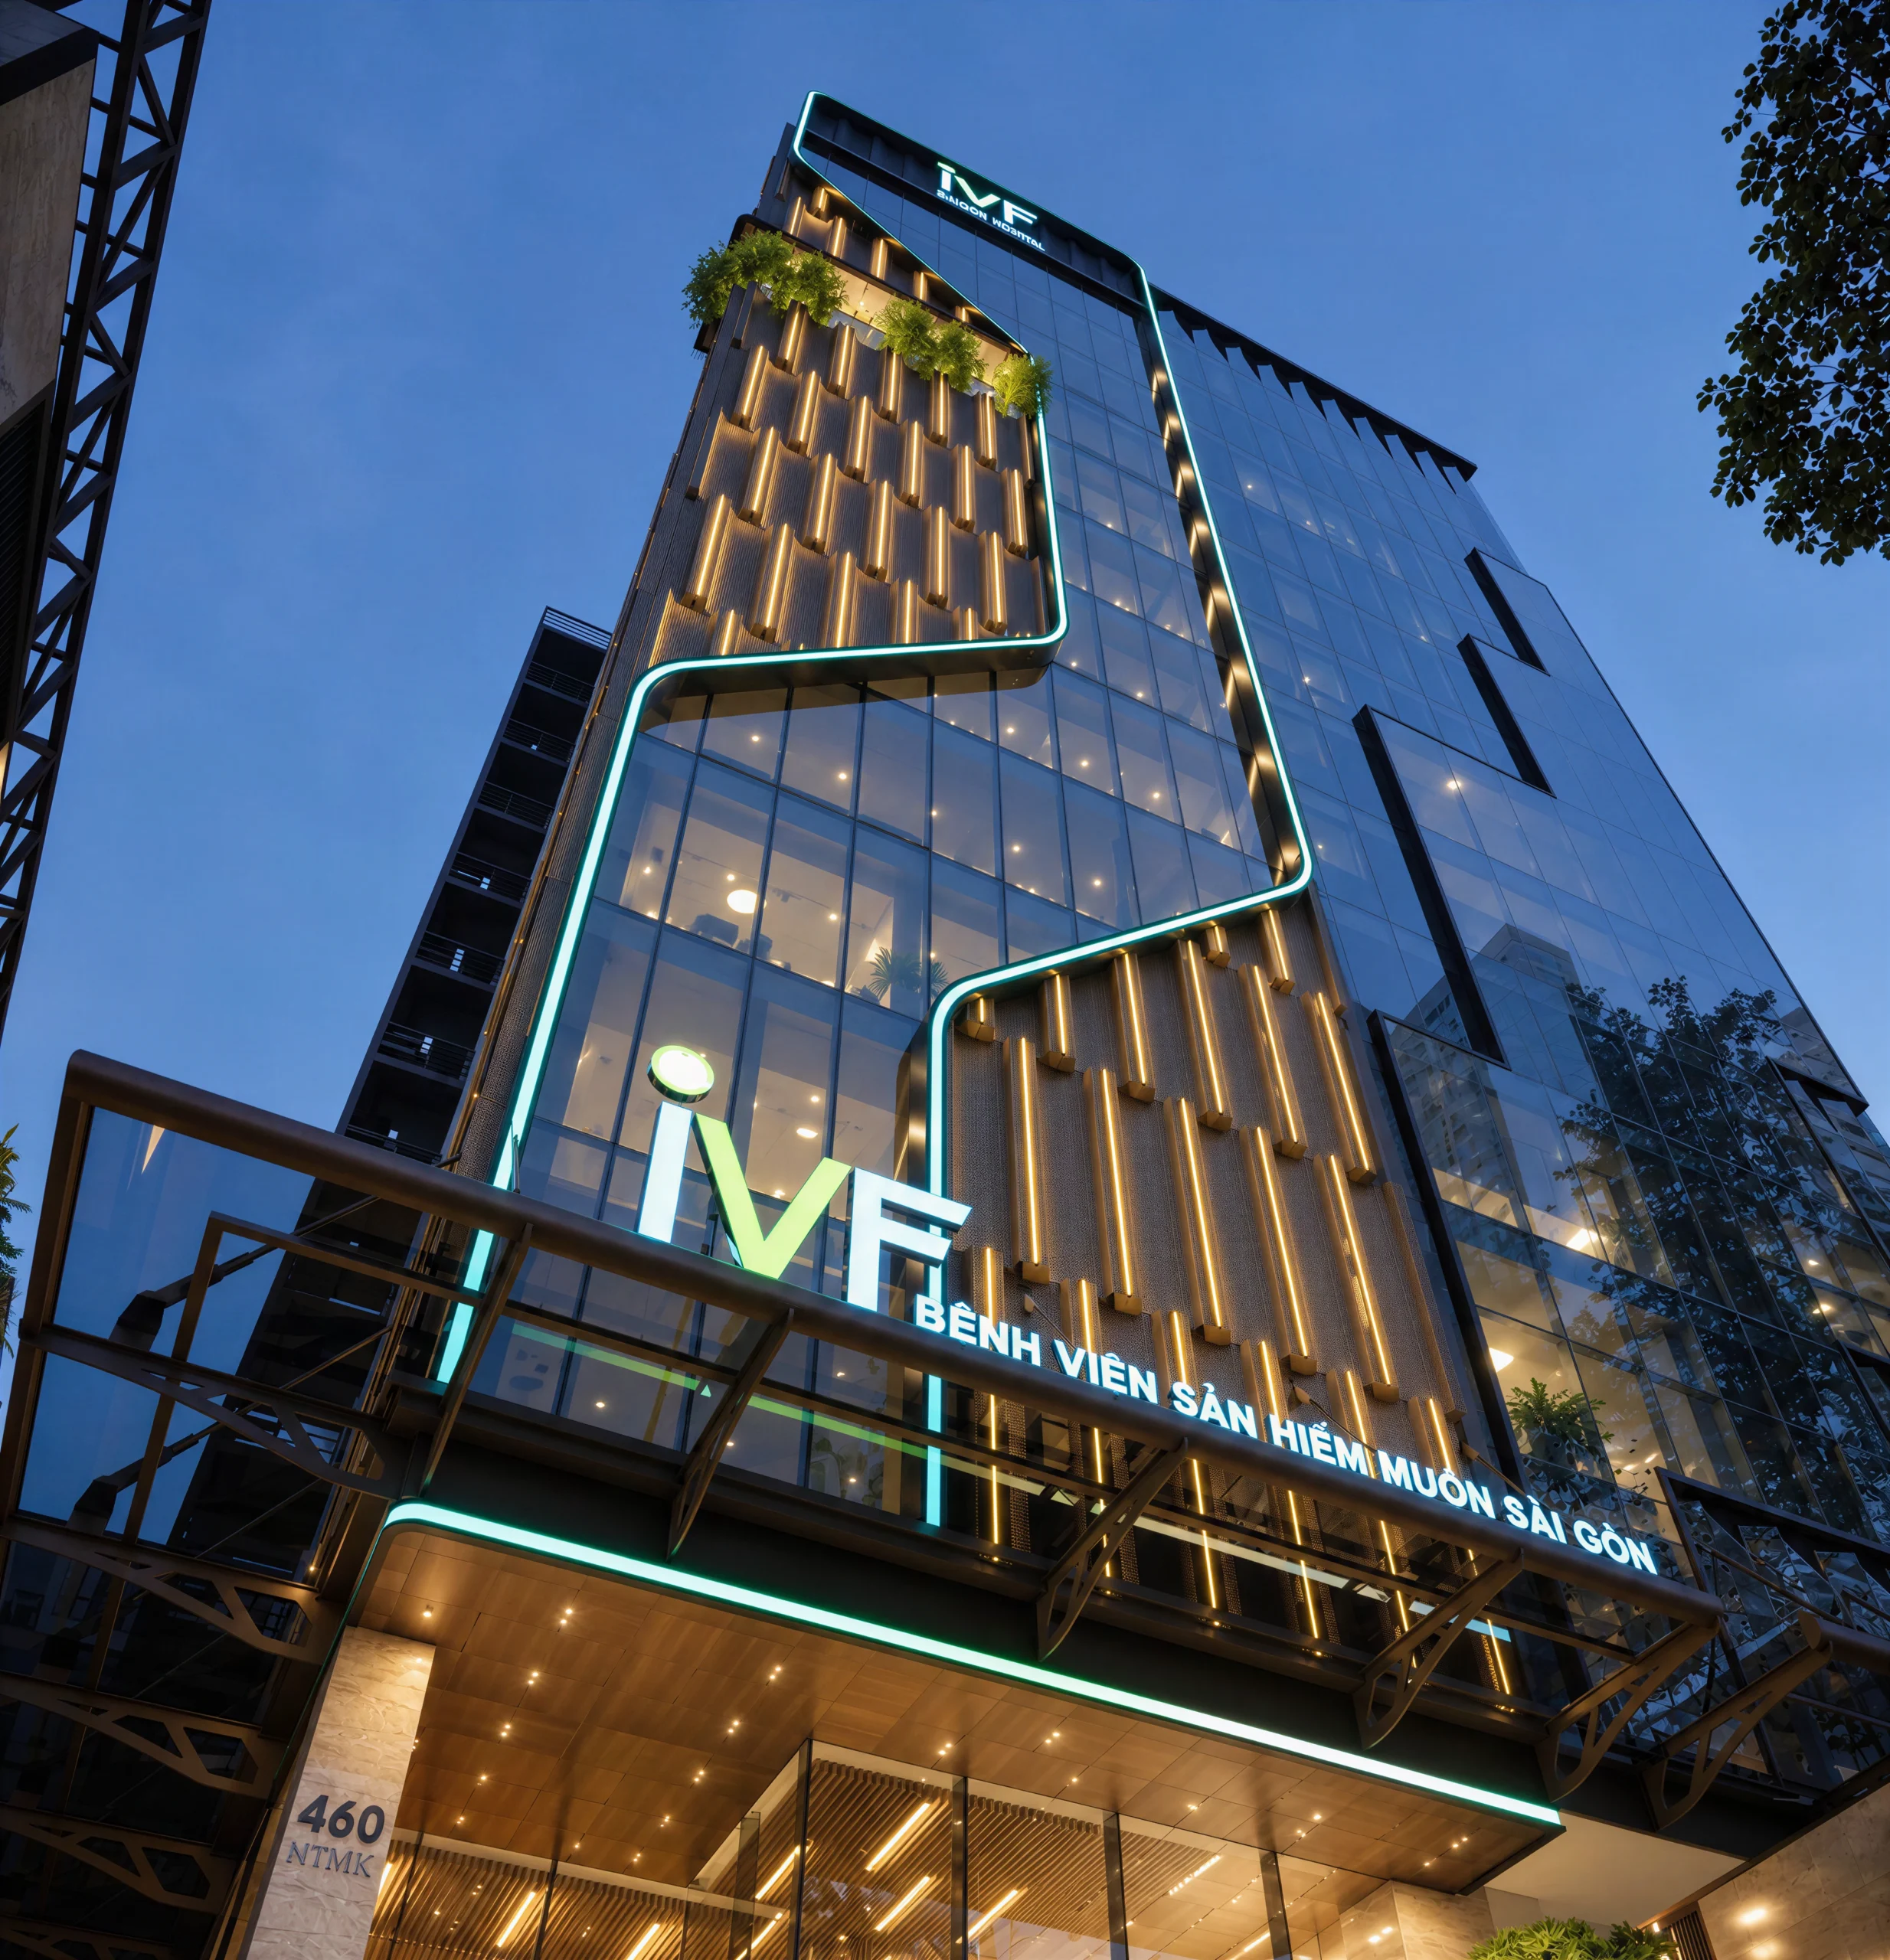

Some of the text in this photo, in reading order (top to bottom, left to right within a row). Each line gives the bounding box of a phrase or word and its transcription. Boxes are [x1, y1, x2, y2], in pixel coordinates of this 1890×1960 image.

[1172, 1381, 1258, 1439] SẢN
[1503, 1494, 1568, 1544] SÀI
[1573, 1519, 1658, 1576] GÒN
[297, 1794, 385, 1844] 460
[286, 1841, 374, 1878] NTMK
